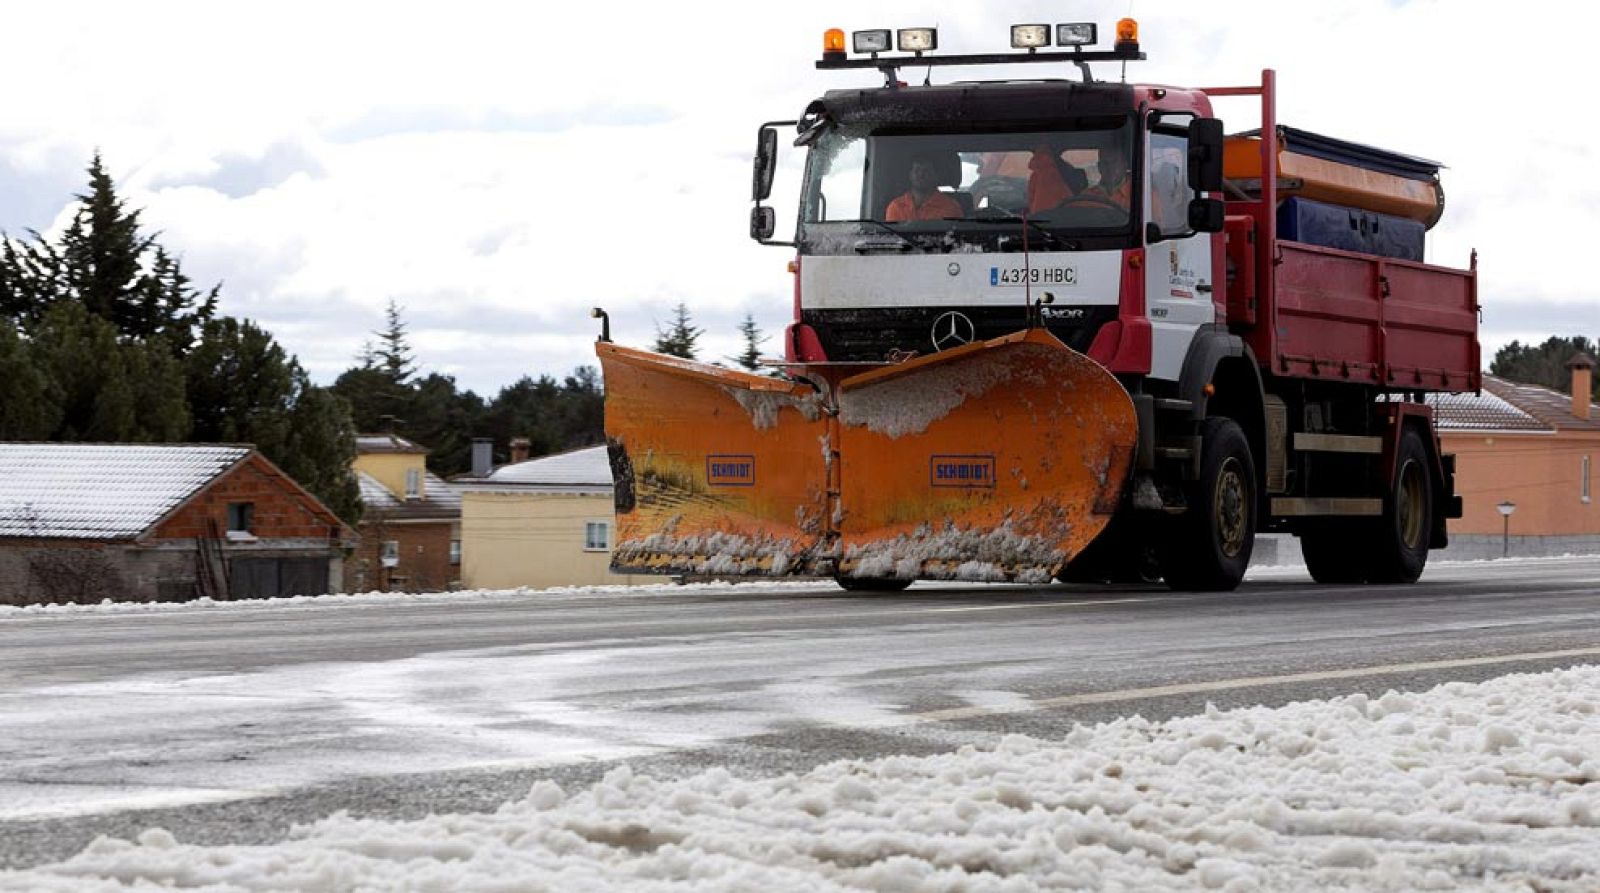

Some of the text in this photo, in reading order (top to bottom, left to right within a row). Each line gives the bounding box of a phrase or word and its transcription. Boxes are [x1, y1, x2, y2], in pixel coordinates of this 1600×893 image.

[1000, 268, 1074, 283] 4379 HBC
[711, 462, 751, 478] SCHMIDT
[935, 463, 989, 480] SCHMIDT
